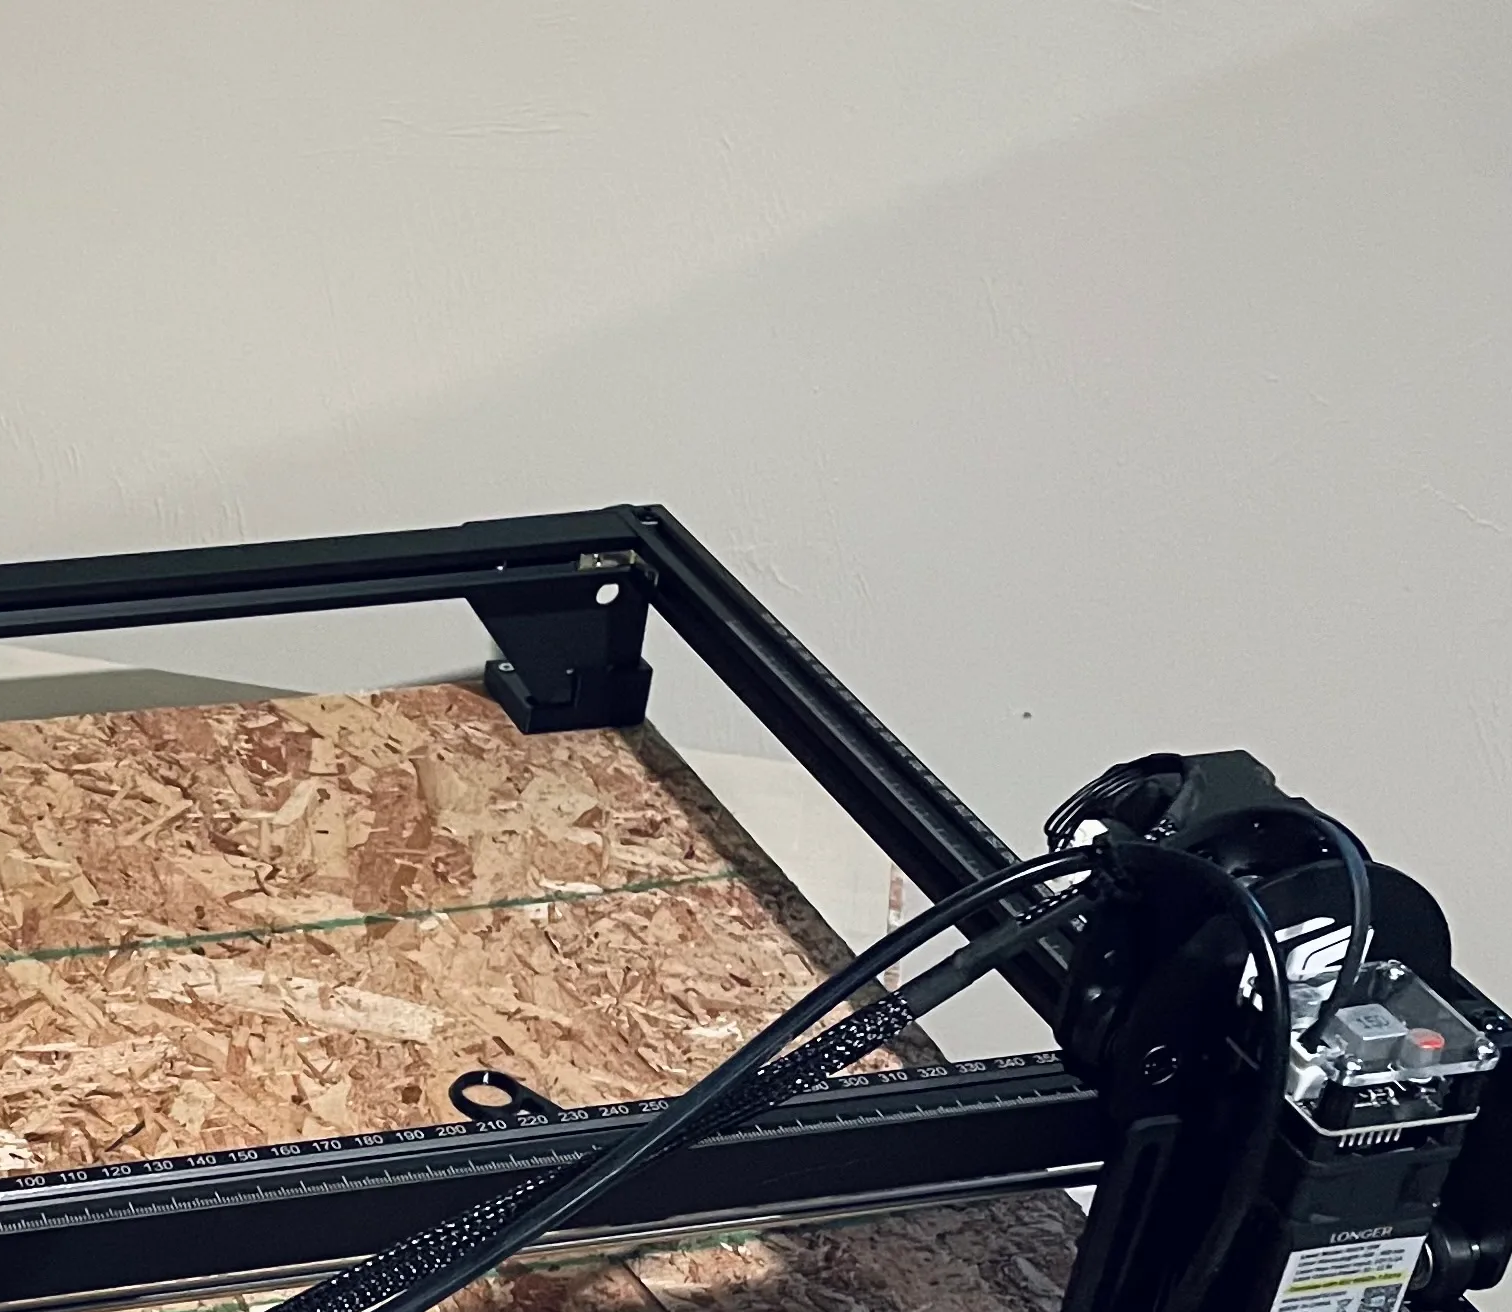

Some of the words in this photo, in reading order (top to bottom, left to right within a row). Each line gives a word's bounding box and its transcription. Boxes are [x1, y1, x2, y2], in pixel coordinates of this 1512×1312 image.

[15, 1176, 46, 1189] 100
[59, 1170, 88, 1182] 110
[102, 1164, 132, 1178] 120
[143, 1159, 173, 1173] 130
[186, 1154, 217, 1168] 140
[228, 1149, 258, 1163] 150
[270, 1144, 301, 1157] 160
[312, 1139, 342, 1152] 170
[354, 1134, 384, 1147] 180
[395, 1129, 425, 1142] 190
[435, 1123, 467, 1137] 200
[476, 1118, 507, 1132] 210
[517, 1113, 549, 1127] 220
[558, 1108, 589, 1122] 230
[598, 1103, 630, 1117] 240
[638, 1098, 669, 1112] 250
[838, 1075, 869, 1087] 300
[878, 1070, 908, 1083] 310
[917, 1066, 947, 1079] 320
[955, 1061, 986, 1074] 330
[994, 1057, 1025, 1069] 340
[1330, 1226, 1393, 1243] LONGER
